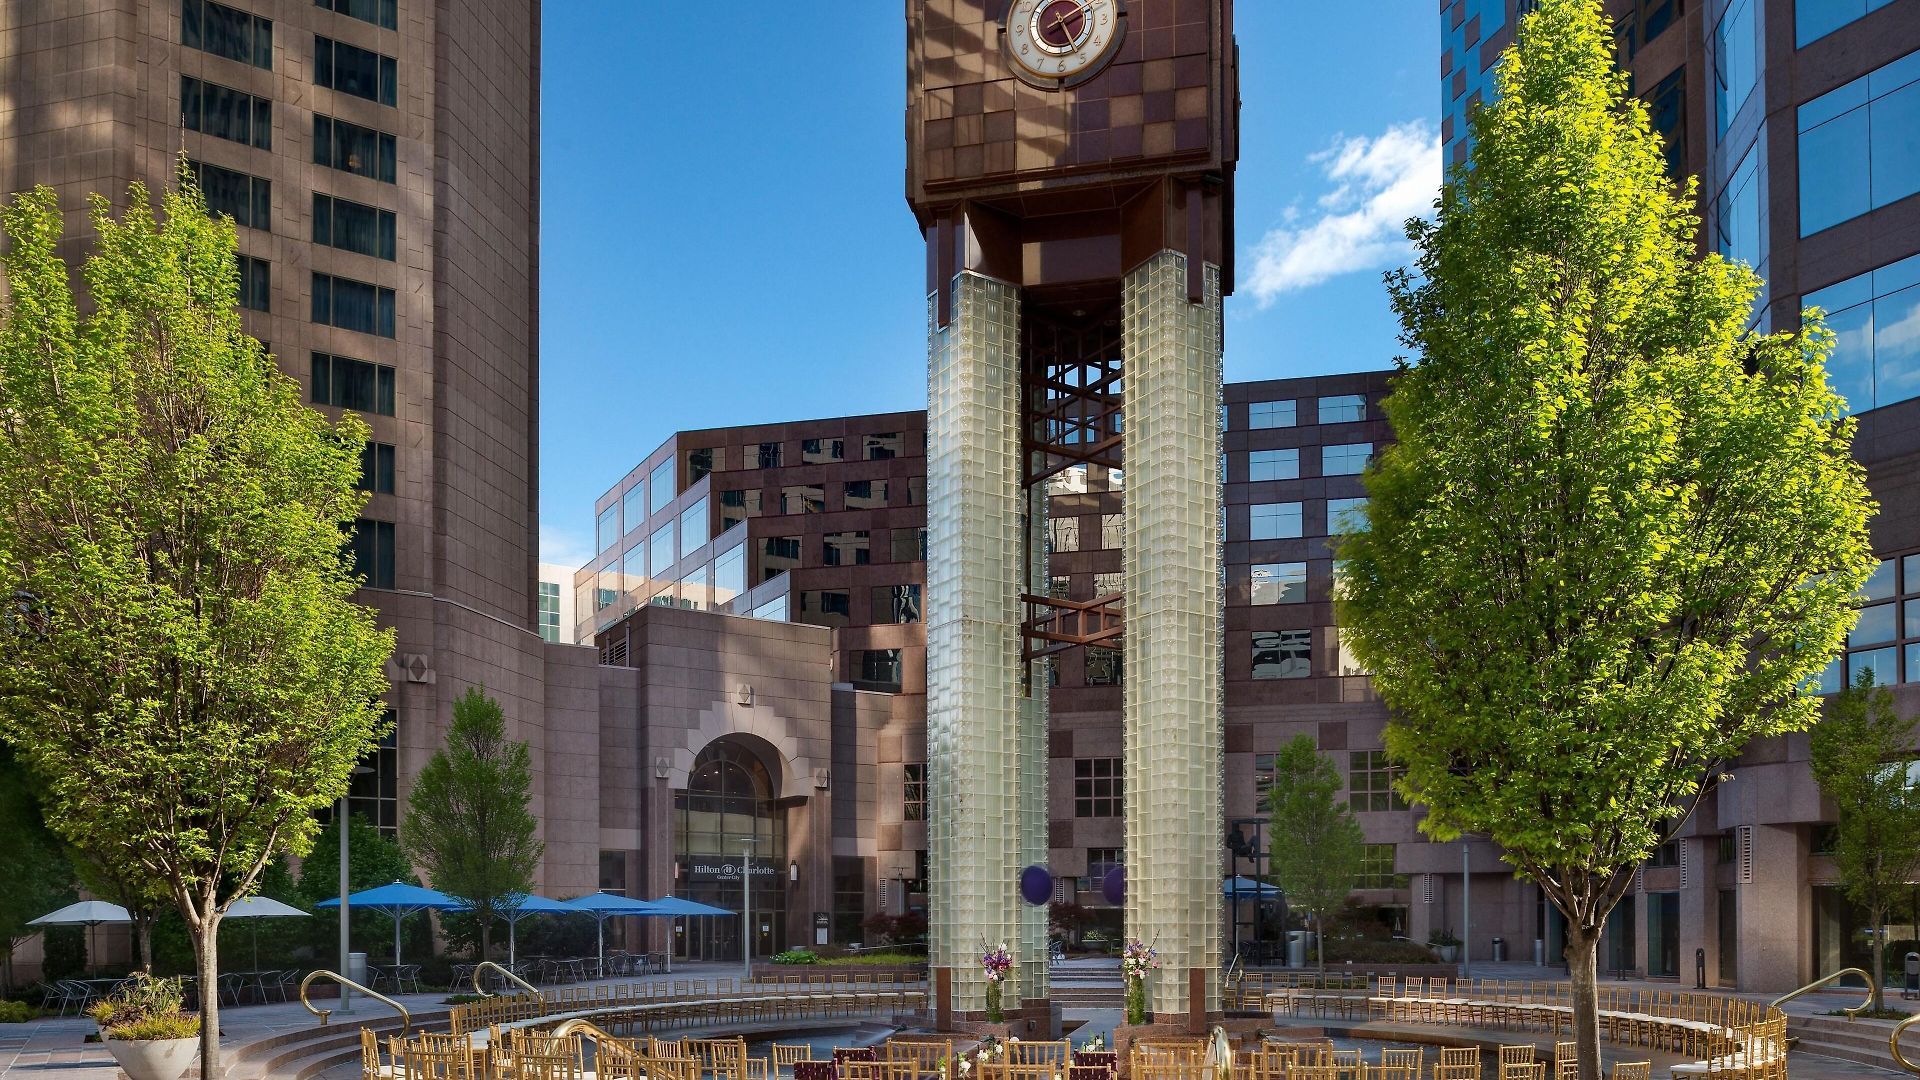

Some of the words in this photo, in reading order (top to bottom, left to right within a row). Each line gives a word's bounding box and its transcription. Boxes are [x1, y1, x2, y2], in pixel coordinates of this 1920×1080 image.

[1100, 13, 1108, 25] 3
[1016, 24, 1024, 36] 9
[1093, 35, 1102, 47] 4
[1021, 43, 1029, 55] 8
[1036, 57, 1045, 70] 7
[1079, 53, 1087, 65] 5
[1057, 60, 1066, 72] 6
[694, 865, 720, 873] Hilton
